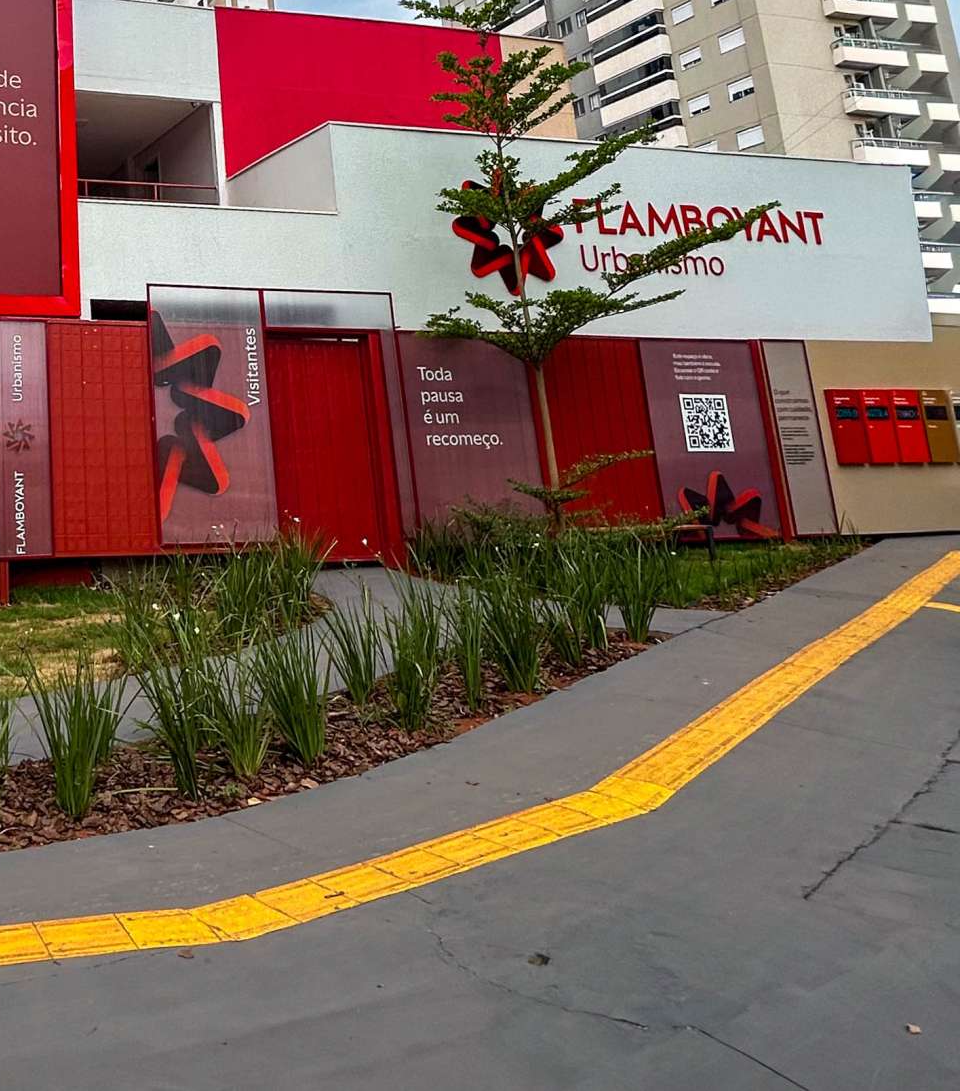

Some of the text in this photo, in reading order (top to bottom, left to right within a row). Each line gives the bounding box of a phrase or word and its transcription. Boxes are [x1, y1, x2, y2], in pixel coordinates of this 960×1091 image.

[247, 327, 261, 406] Visitantes
[416, 366, 453, 381] Toda
[421, 390, 464, 405] pausa
[423, 409, 460, 424] é um
[11, 334, 25, 555] FLAMBOYANT Urbanismo
[425, 433, 504, 449] recomeço.
